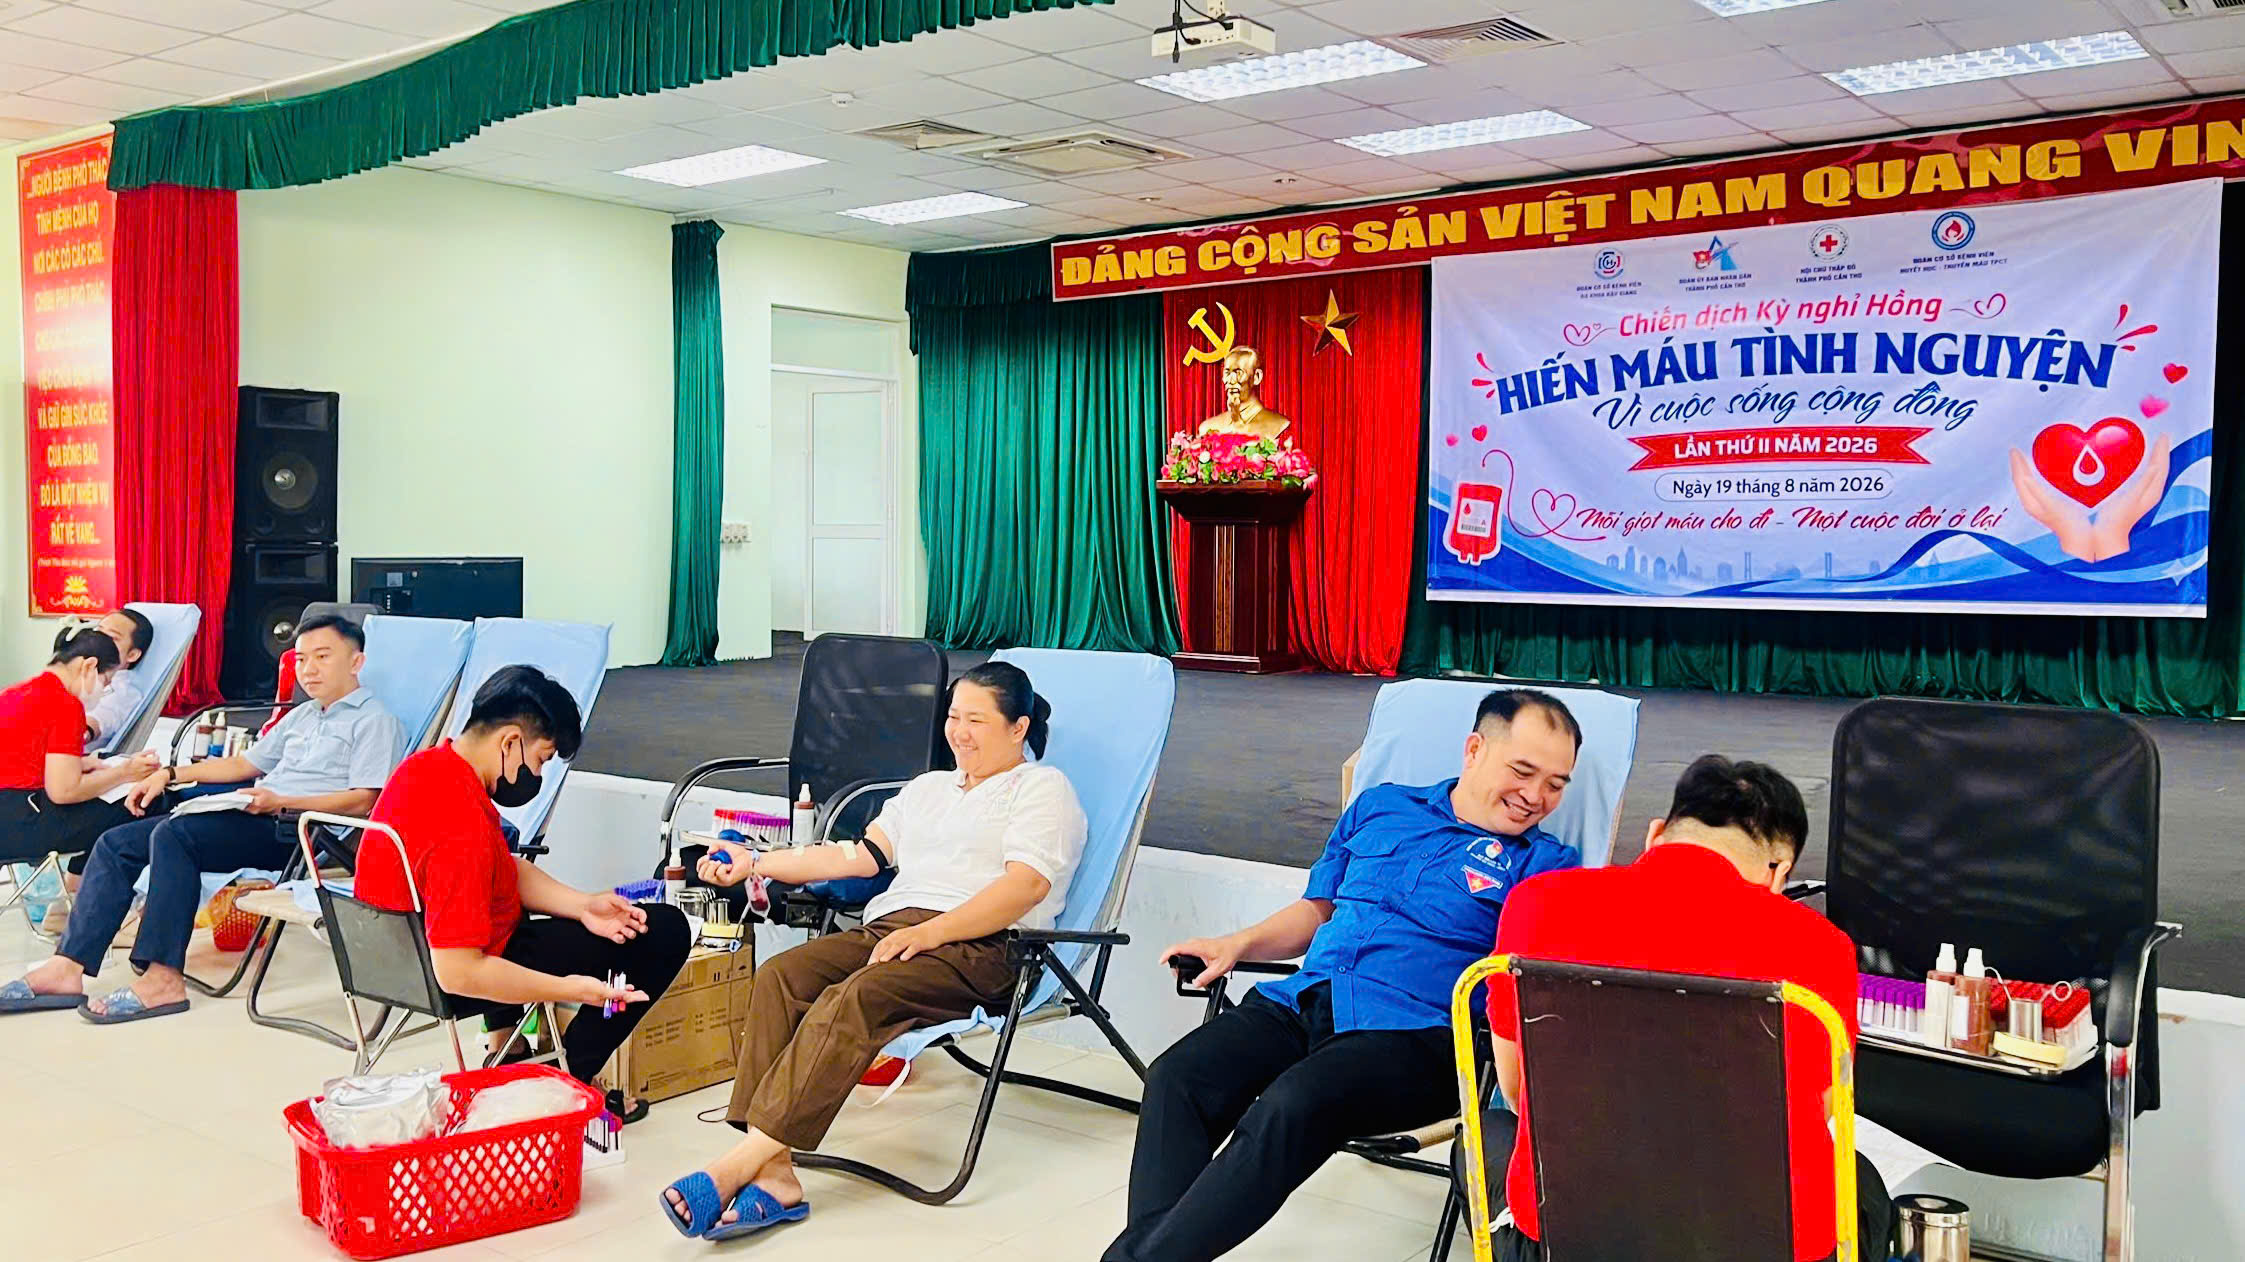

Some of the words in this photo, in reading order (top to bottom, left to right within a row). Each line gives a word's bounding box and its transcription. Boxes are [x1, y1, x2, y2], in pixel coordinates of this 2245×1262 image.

[1061, 244, 1187, 286] ĐẢNG
[1198, 226, 1341, 274] CỘNG
[1353, 205, 1467, 254] SẢN
[1480, 190, 1616, 243] VIỆT
[1630, 173, 1786, 224] NAM
[1802, 139, 2082, 207] QUANG
[1619, 304, 1686, 337] Chiến
[1695, 302, 1747, 331] dịch
[1756, 298, 1789, 326] Kỳ
[1797, 292, 1860, 324] nghỉ
[1866, 288, 1942, 322] Hồng
[1495, 350, 1600, 415] HIẾN
[1610, 336, 1719, 392] MÁU
[1731, 327, 1858, 377] TÌNH
[1873, 328, 2118, 392] NGUYỆN
[1593, 392, 1642, 430] Vì
[1650, 391, 1717, 423] cuộc
[1726, 382, 1799, 425] sống
[1808, 384, 1884, 423] cộng
[1893, 380, 1979, 431] đồng
[1674, 435, 1712, 459] LẦN
[1715, 437, 1757, 455] THỨ
[1759, 437, 1770, 454] II
[1774, 433, 1821, 453] NĂM
[1824, 436, 1878, 454] 2026
[1673, 480, 1712, 498] Ngày
[1716, 480, 1732, 494] 19
[1736, 478, 1780, 497] tháng
[1784, 479, 1795, 493] 8
[1800, 478, 1835, 493] năm
[1840, 476, 1884, 492] 2026
[1576, 508, 1623, 529] Mỗi
[1622, 511, 1663, 537] giọt
[1665, 512, 1705, 529] máu
[1710, 507, 1742, 529] cho
[1749, 507, 1774, 529] đi
[1792, 506, 1849, 532] Một
[1850, 511, 1900, 531] cuộc
[1905, 505, 1947, 528] đời
[1948, 508, 1966, 528] ở
[1970, 505, 2008, 530] lại
